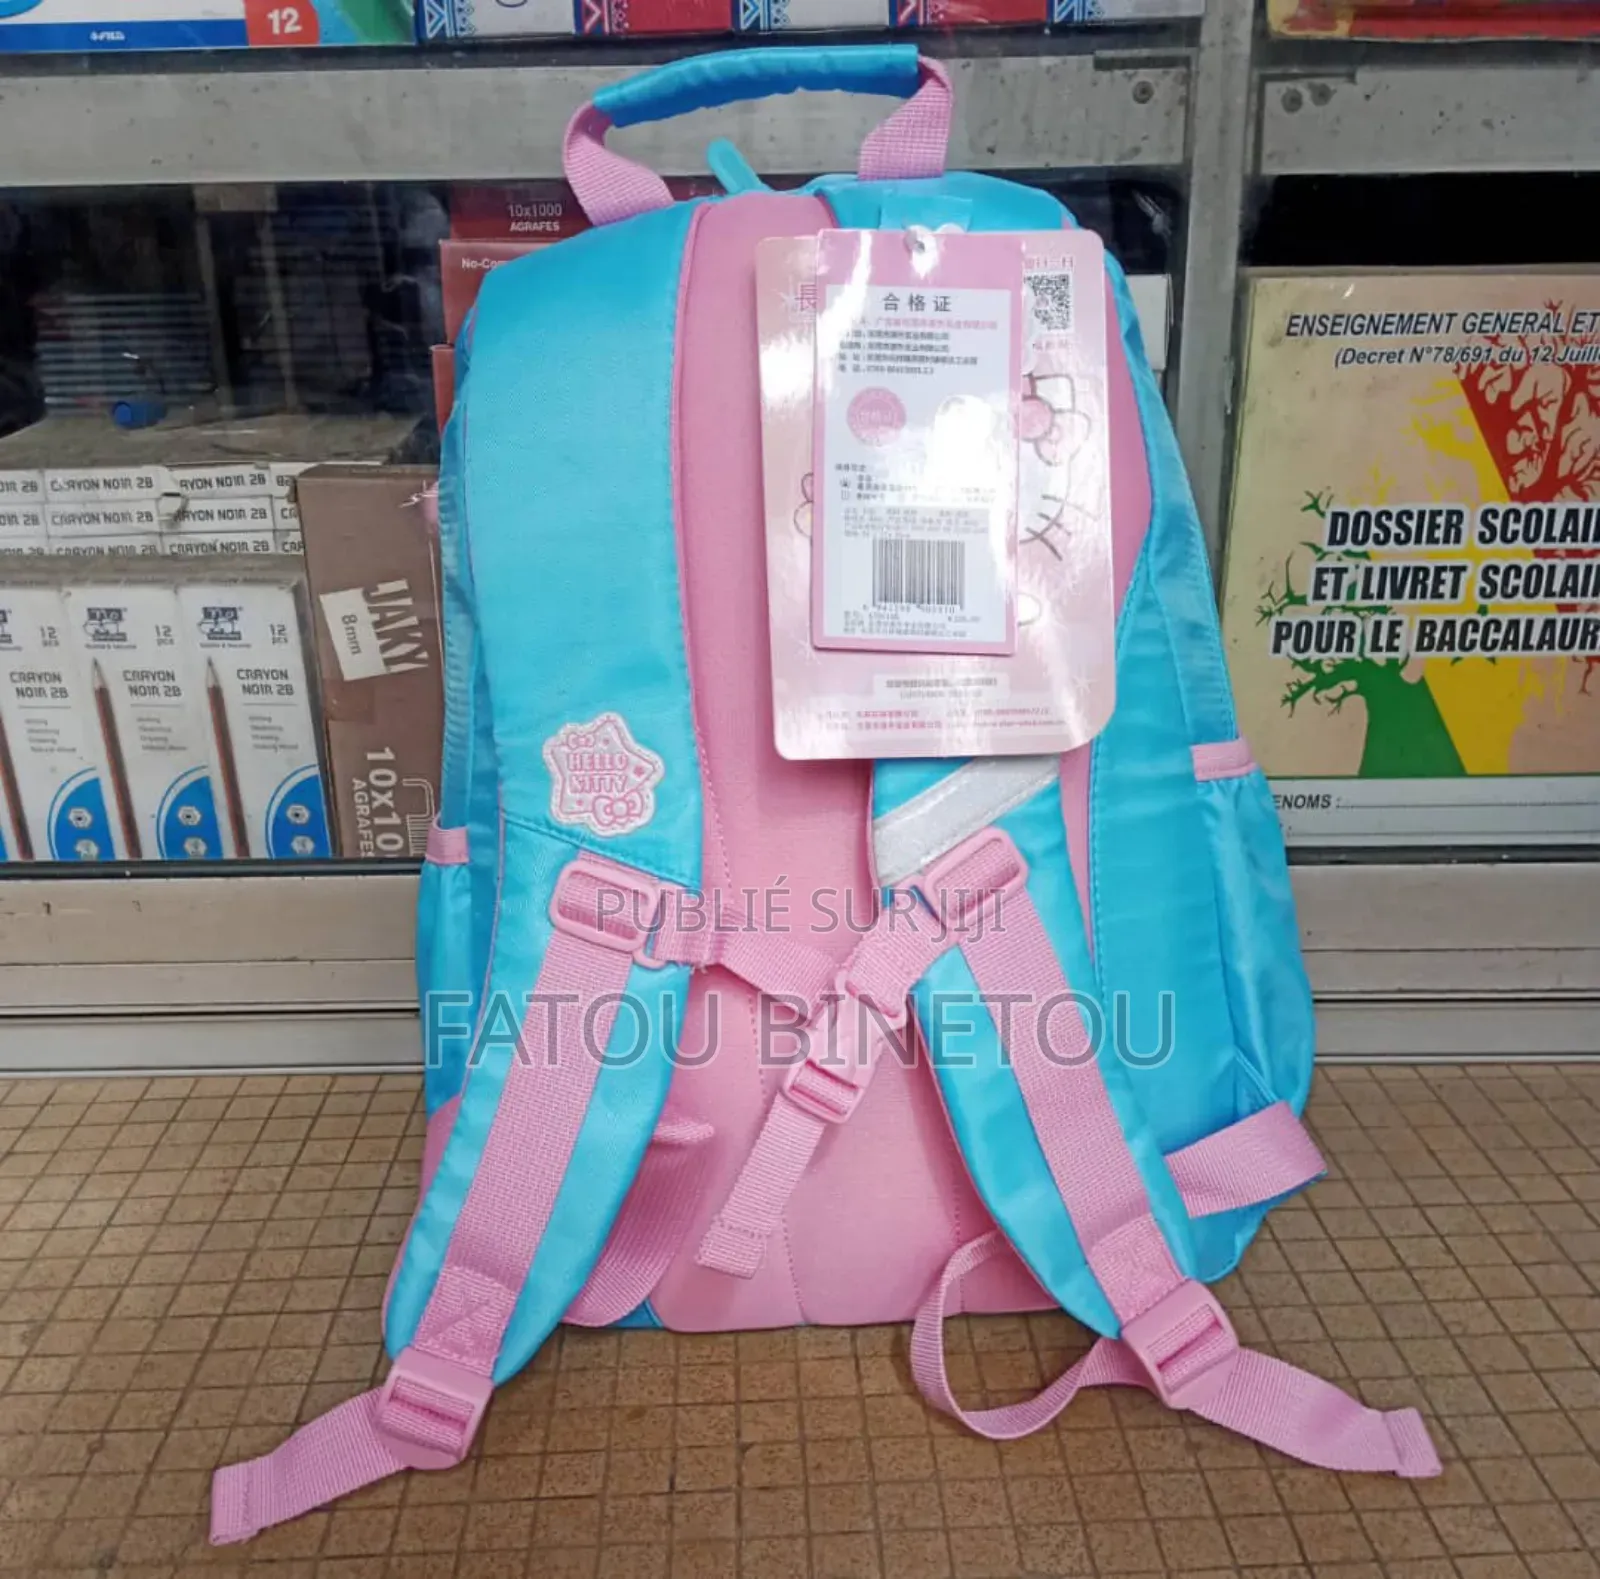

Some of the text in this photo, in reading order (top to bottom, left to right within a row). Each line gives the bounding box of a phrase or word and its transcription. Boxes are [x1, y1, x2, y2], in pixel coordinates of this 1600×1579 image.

[266, 6, 302, 35] 12
[510, 221, 560, 232] AGRAFES
[882, 291, 953, 313] 合格证
[1286, 311, 1600, 336] ENSEIGNEMENT GENERAL ET
[1334, 345, 1600, 369] (Decret N°78/691 du 12 Juill
[103, 478, 132, 490] NOIR
[136, 476, 153, 488] 2B
[215, 474, 244, 488] NOIR
[249, 473, 266, 485] 2B
[23, 513, 40, 526] 2B
[103, 511, 133, 524] NOIR
[136, 510, 153, 522] 2B
[218, 508, 246, 520] NOIR
[250, 508, 267, 519] 2B
[1327, 509, 1464, 546] DOSSIER
[169, 540, 269, 555] CRAYON NOIR 2B
[1312, 566, 1349, 600] ET
[1361, 565, 1467, 600] LIVRET
[40, 625, 57, 639] 12
[155, 625, 172, 638] 12
[270, 623, 287, 636] 12
[341, 614, 362, 655] 8mm
[1271, 620, 1356, 654] POUR
[1370, 620, 1404, 653] LE
[10, 671, 62, 684] CRAYON
[123, 670, 175, 682] CRAYON
[237, 668, 288, 680] CRAYON
[16, 687, 69, 699] NOIR 2B
[128, 685, 182, 697] NOIR 2B
[242, 683, 294, 696] NOIR 2B
[567, 752, 628, 772] HELLO
